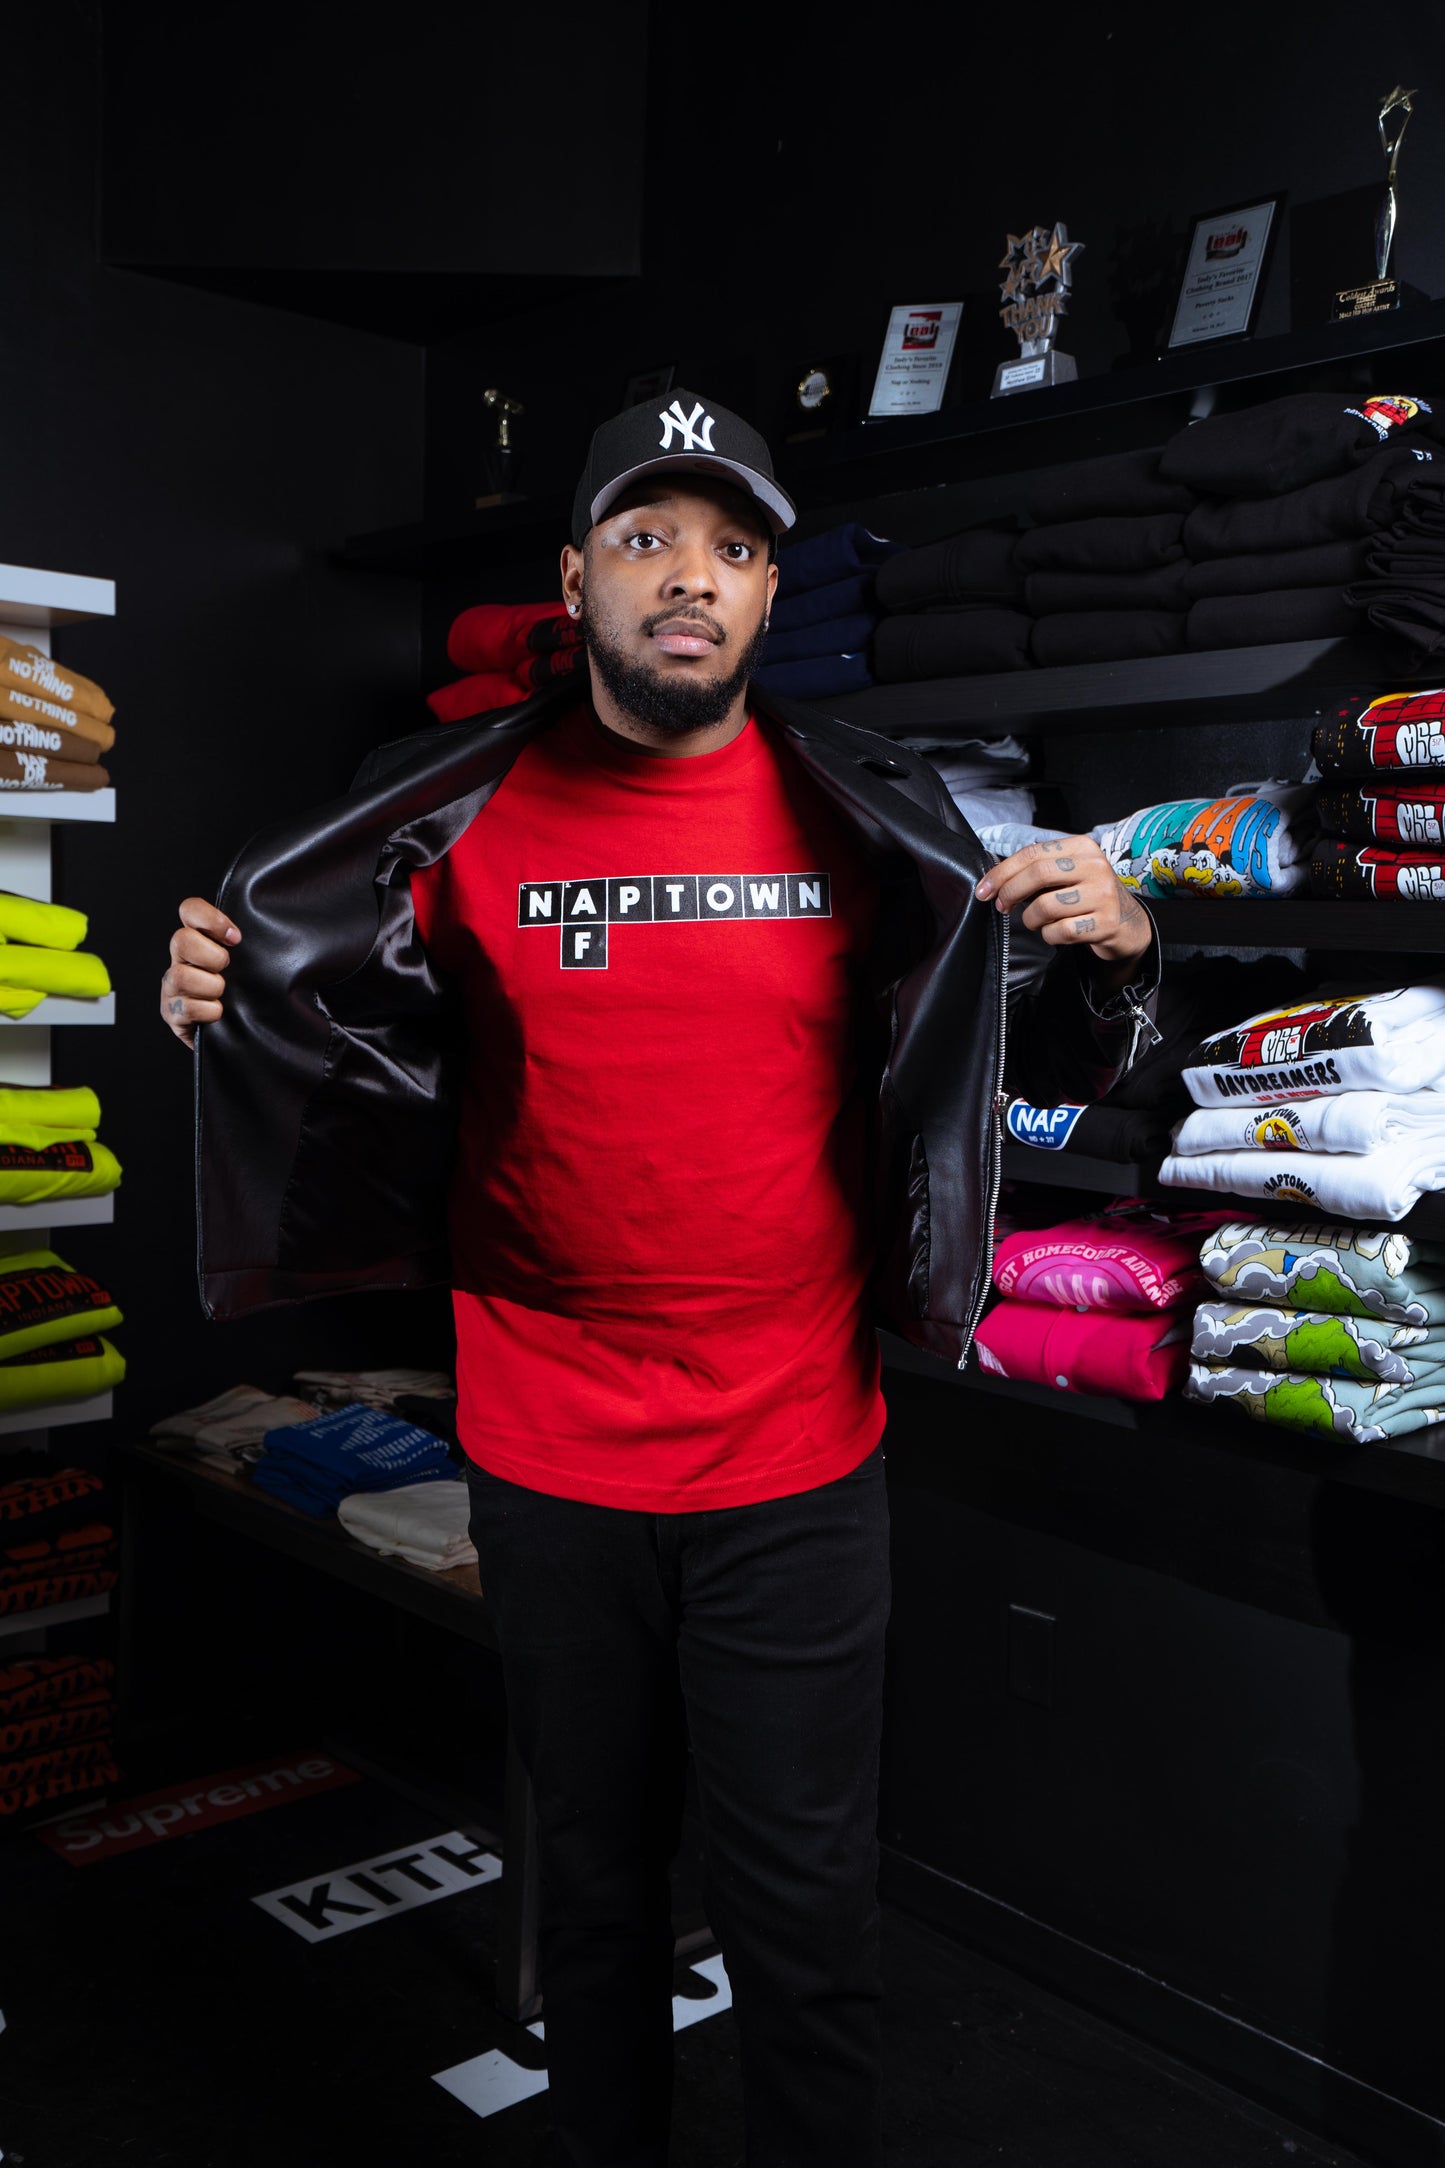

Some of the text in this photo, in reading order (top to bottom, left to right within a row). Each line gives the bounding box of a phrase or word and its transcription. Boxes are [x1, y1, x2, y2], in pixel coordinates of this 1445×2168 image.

[1000, 293, 1064, 328] THANK
[1014, 314, 1055, 343] YOU
[658, 400, 716, 452] NY
[9, 658, 74, 701] NOTHING
[9, 690, 77, 727] NOTHING
[0, 725, 61, 752] OTHING
[529, 882, 821, 918] NAPTOWN
[1213, 1058, 1342, 1098] DAYDREAMERS
[1016, 1107, 1069, 1133] NAP
[1253, 1108, 1301, 1128] NAPTOWN
[1263, 1173, 1315, 1198] NAPTOWN
[1022, 1244, 1127, 1267] HOMECOURT
[55, 1758, 335, 1852] Supreme
[277, 1834, 503, 1930] KITH
